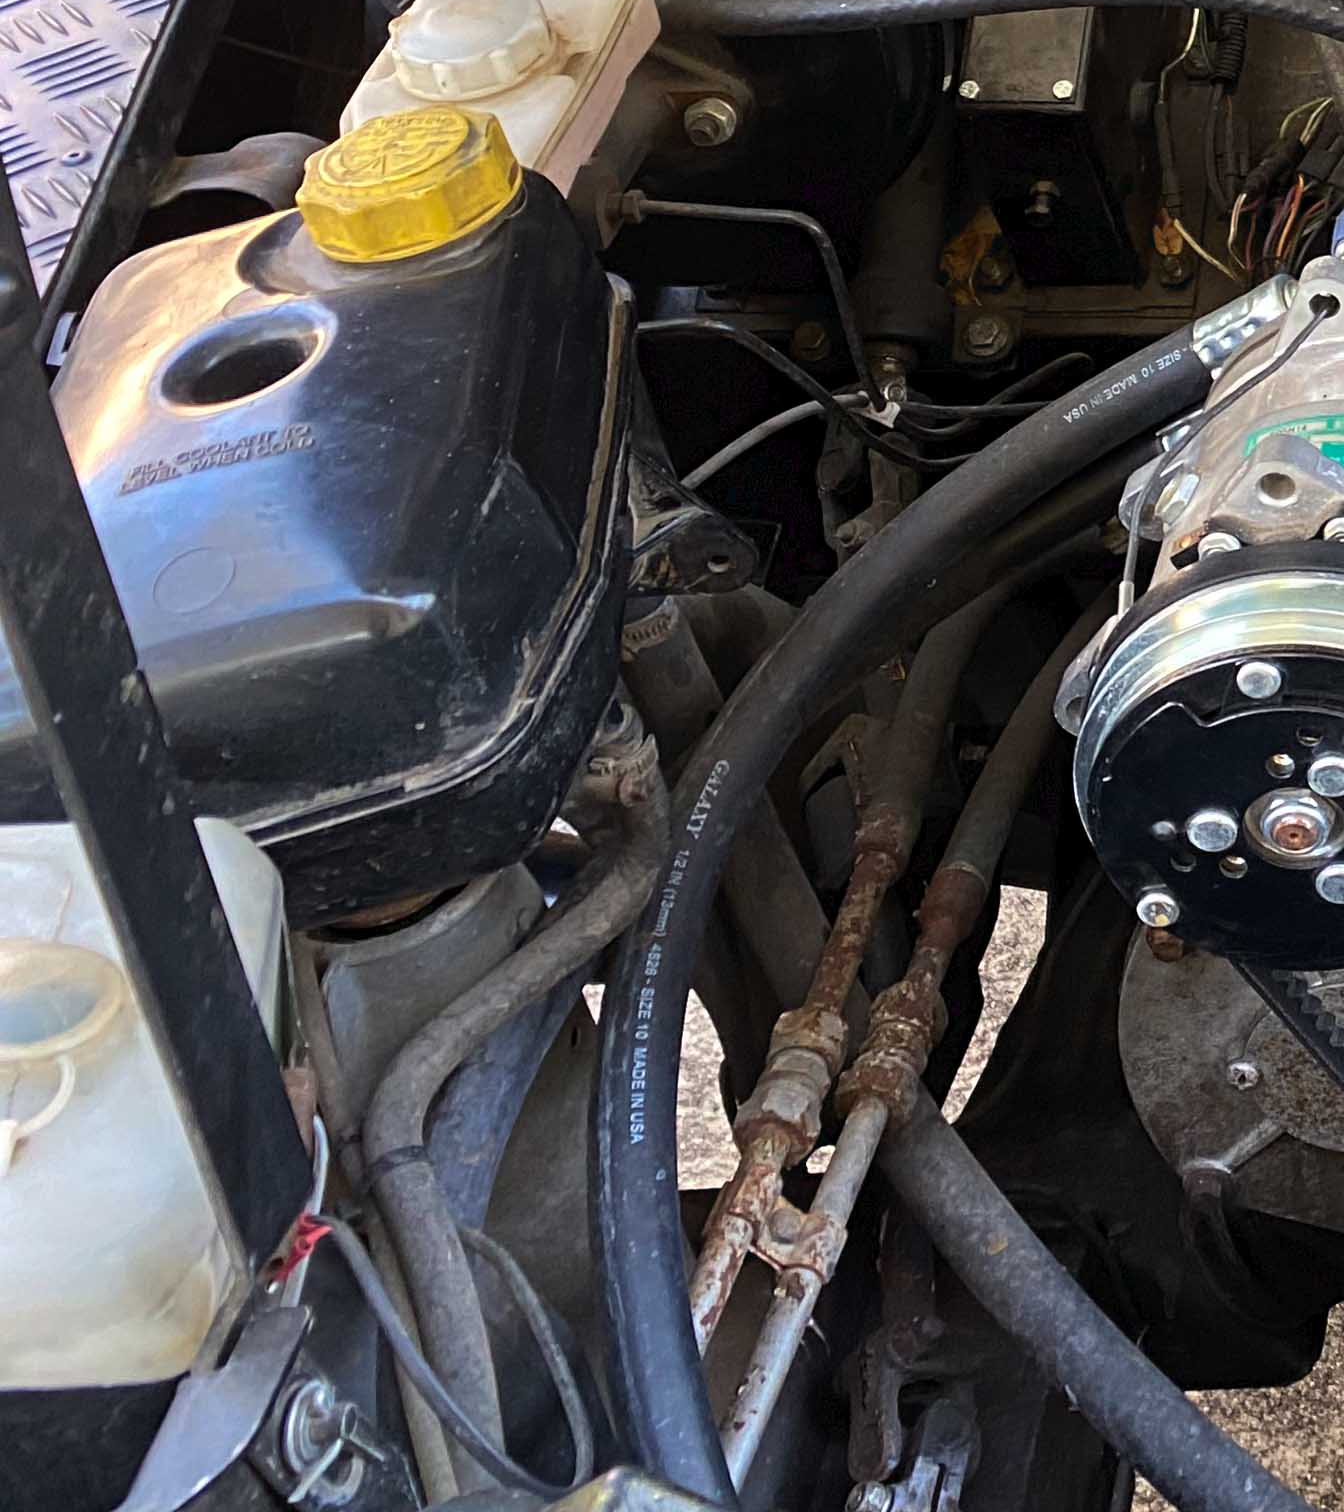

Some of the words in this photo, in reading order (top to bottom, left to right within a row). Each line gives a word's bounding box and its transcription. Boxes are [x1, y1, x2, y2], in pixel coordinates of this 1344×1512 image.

[1141, 364, 1155, 378] 10
[1155, 349, 1182, 370] SIZE
[1103, 374, 1138, 400] MADE
[1063, 403, 1088, 424] USA
[176, 429, 277, 465] COOLANT
[190, 447, 251, 474] WHEN
[255, 438, 316, 457] COLD
[686, 759, 730, 840] GALAXY
[668, 871, 684, 886] IN
[653, 887, 678, 937] (13mm)
[638, 987, 655, 1020] SIZE
[634, 1023, 649, 1041] 10
[630, 1047, 647, 1090] MADE
[630, 1092, 645, 1110] IN
[629, 1112, 645, 1145] USA
